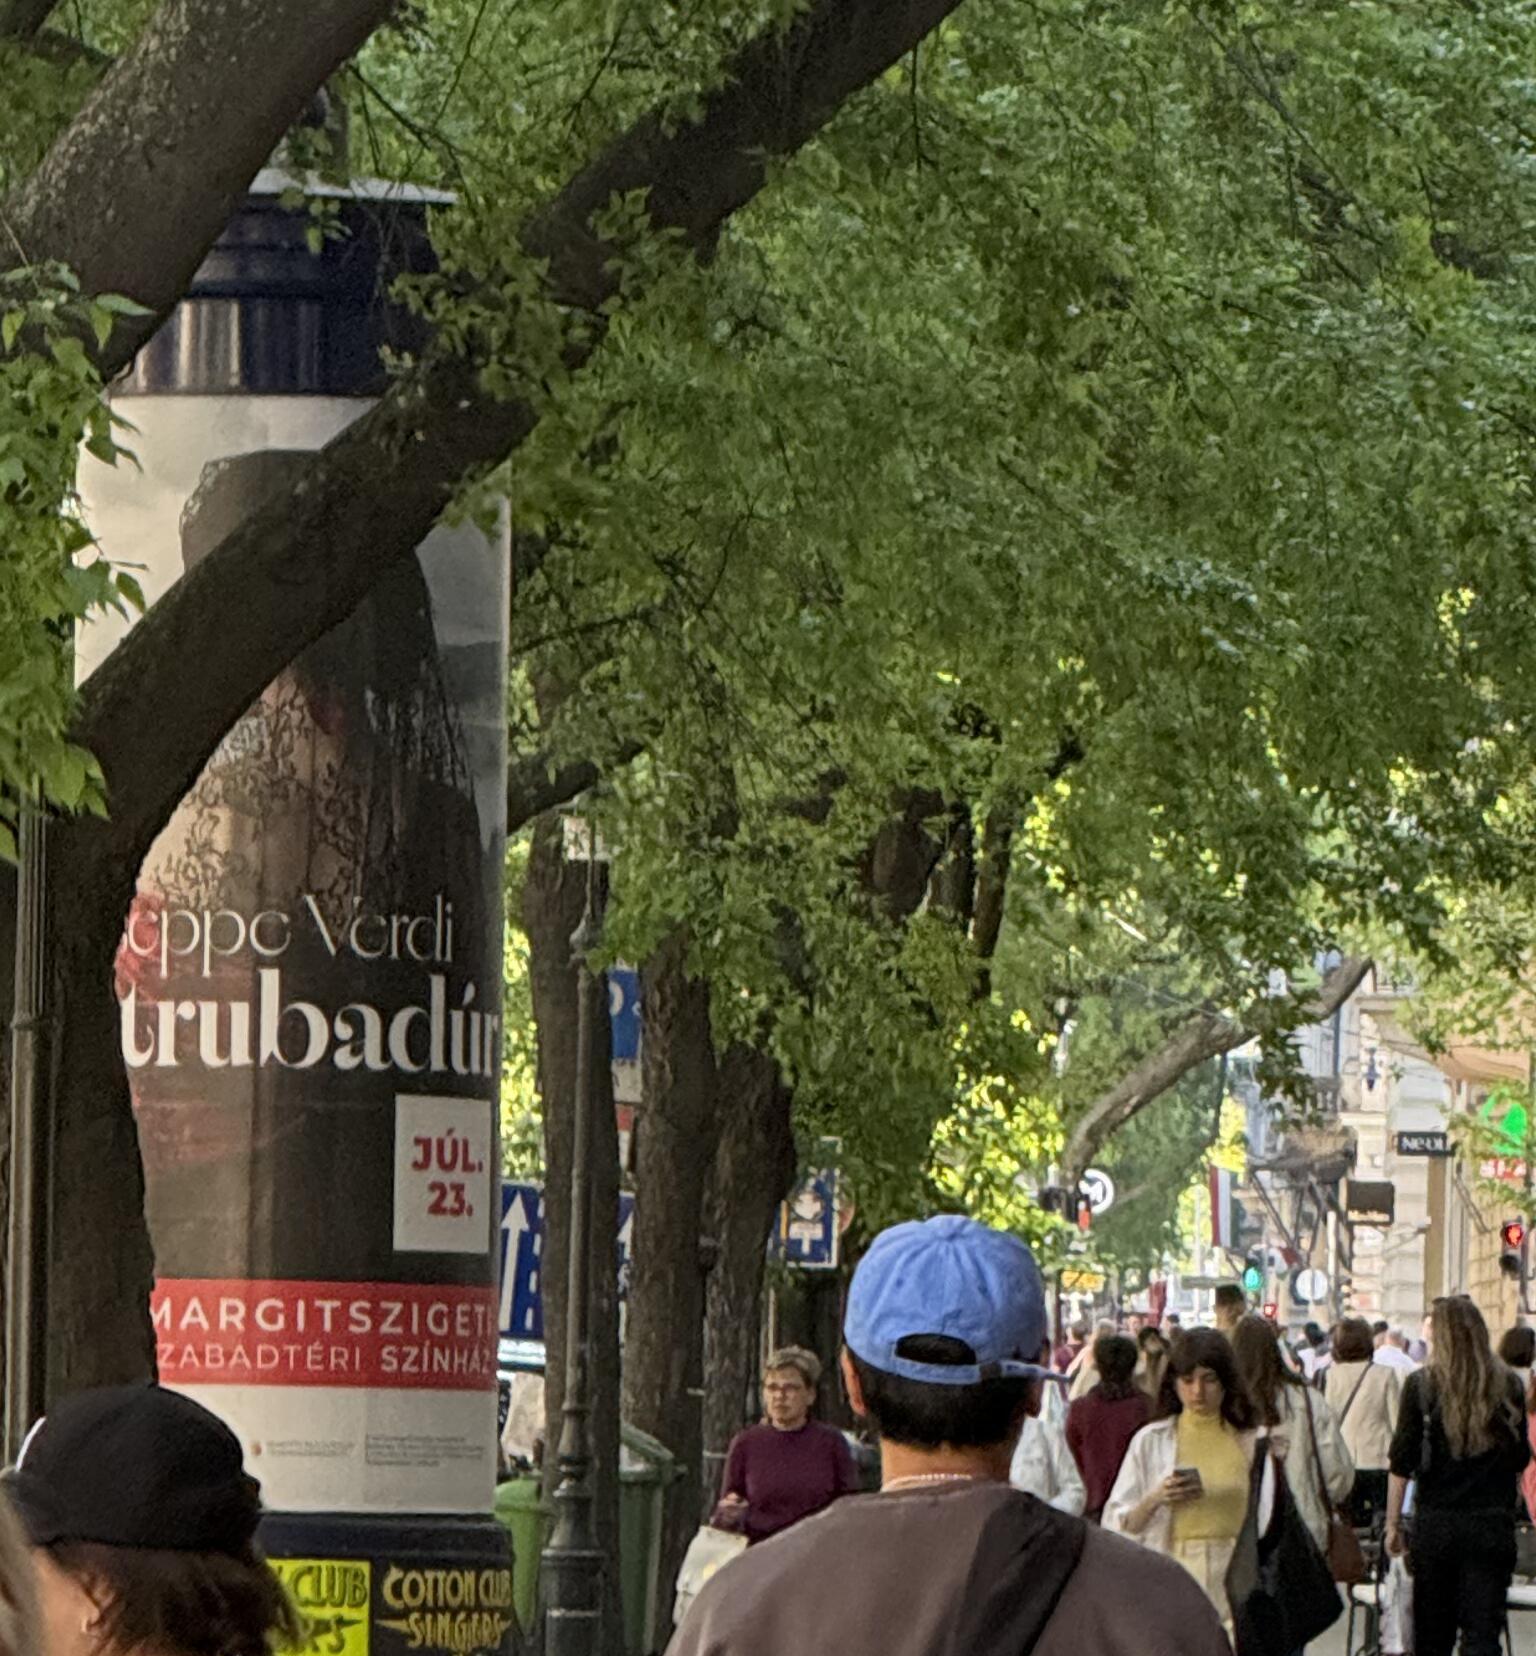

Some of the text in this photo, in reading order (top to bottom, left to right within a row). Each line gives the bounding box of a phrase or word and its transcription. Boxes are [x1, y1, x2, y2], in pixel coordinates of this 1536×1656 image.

[121, 893, 453, 978] eppe Verdi
[120, 967, 499, 1079] trubadúr
[411, 1127, 484, 1174] JÚL.
[427, 1180, 474, 1218] 23.
[150, 1296, 492, 1338] MARGITSZIGETI
[157, 1339, 491, 1375] ZABADTÉRI SZÍNHÁZ
[290, 1564, 368, 1608] CLUB
[382, 1565, 512, 1609] COTTON CLUB
[407, 1611, 501, 1651] SINGERS
